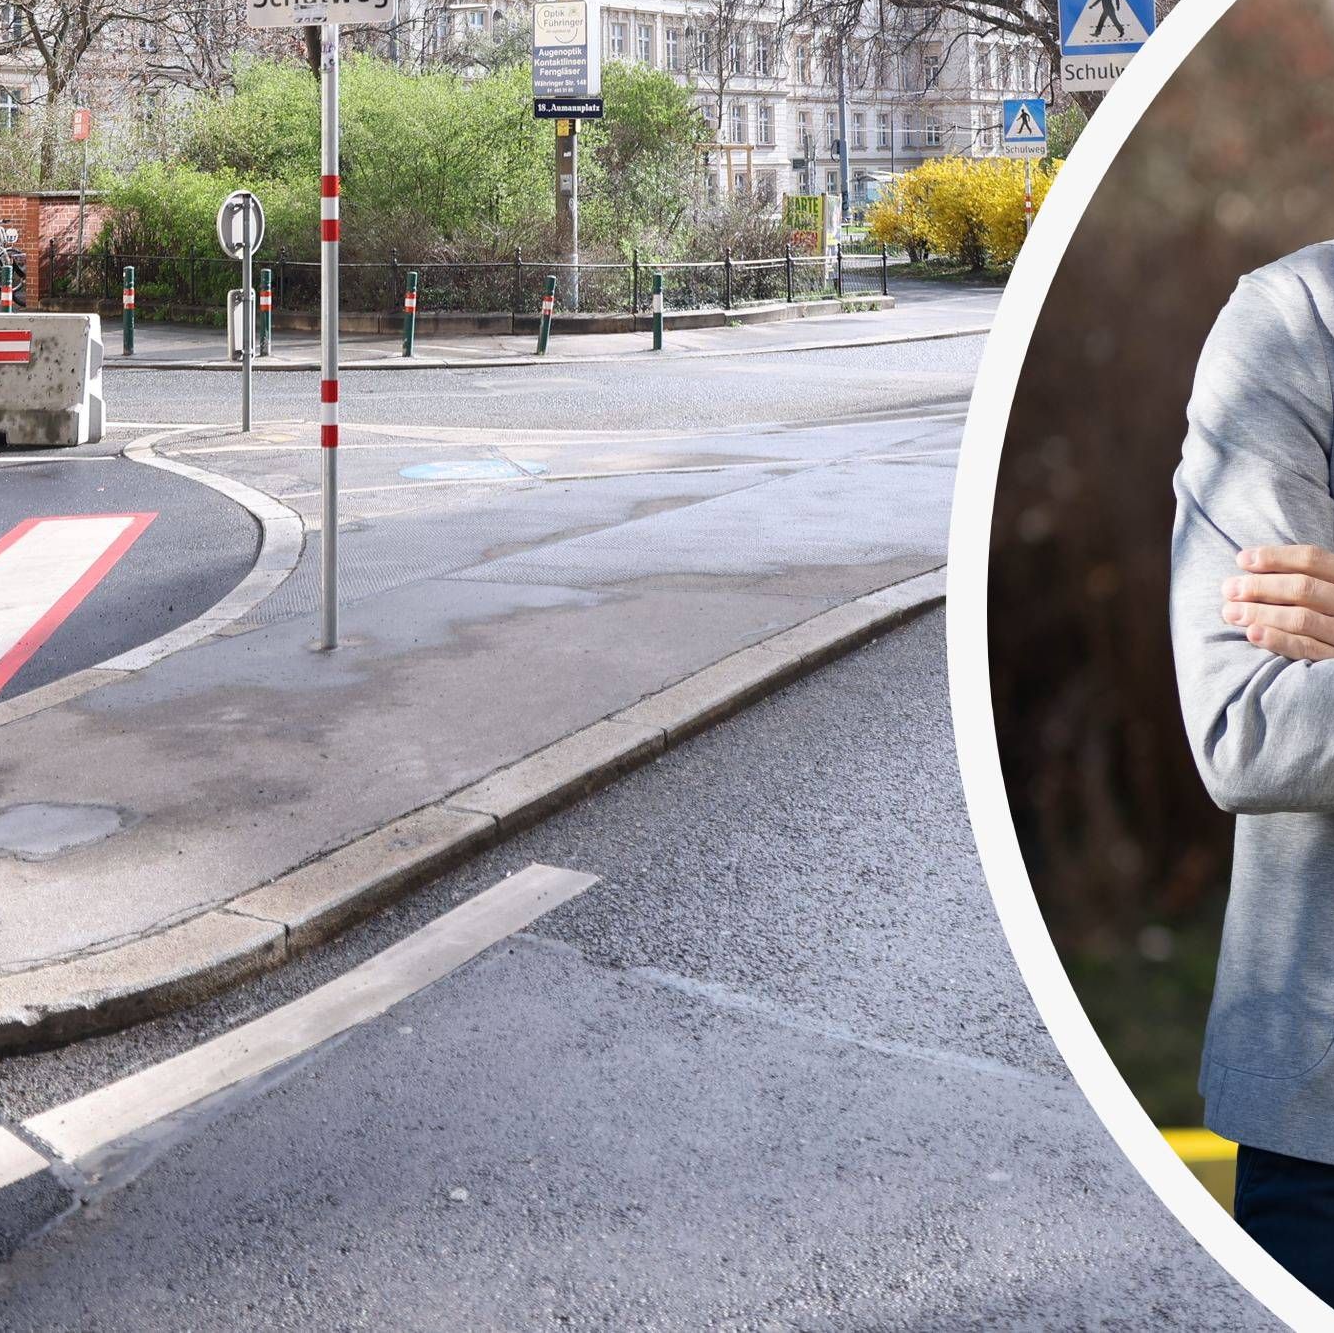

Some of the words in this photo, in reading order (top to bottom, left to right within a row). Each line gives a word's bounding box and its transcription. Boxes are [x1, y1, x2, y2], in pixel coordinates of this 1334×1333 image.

[543, 9, 564, 18] Optik
[538, 47, 582, 57] Augenoptik
[534, 58, 586, 67] Kontaktlinsen
[539, 67, 580, 77] Ferngläser
[1005, 145, 1046, 154] Schulweg
